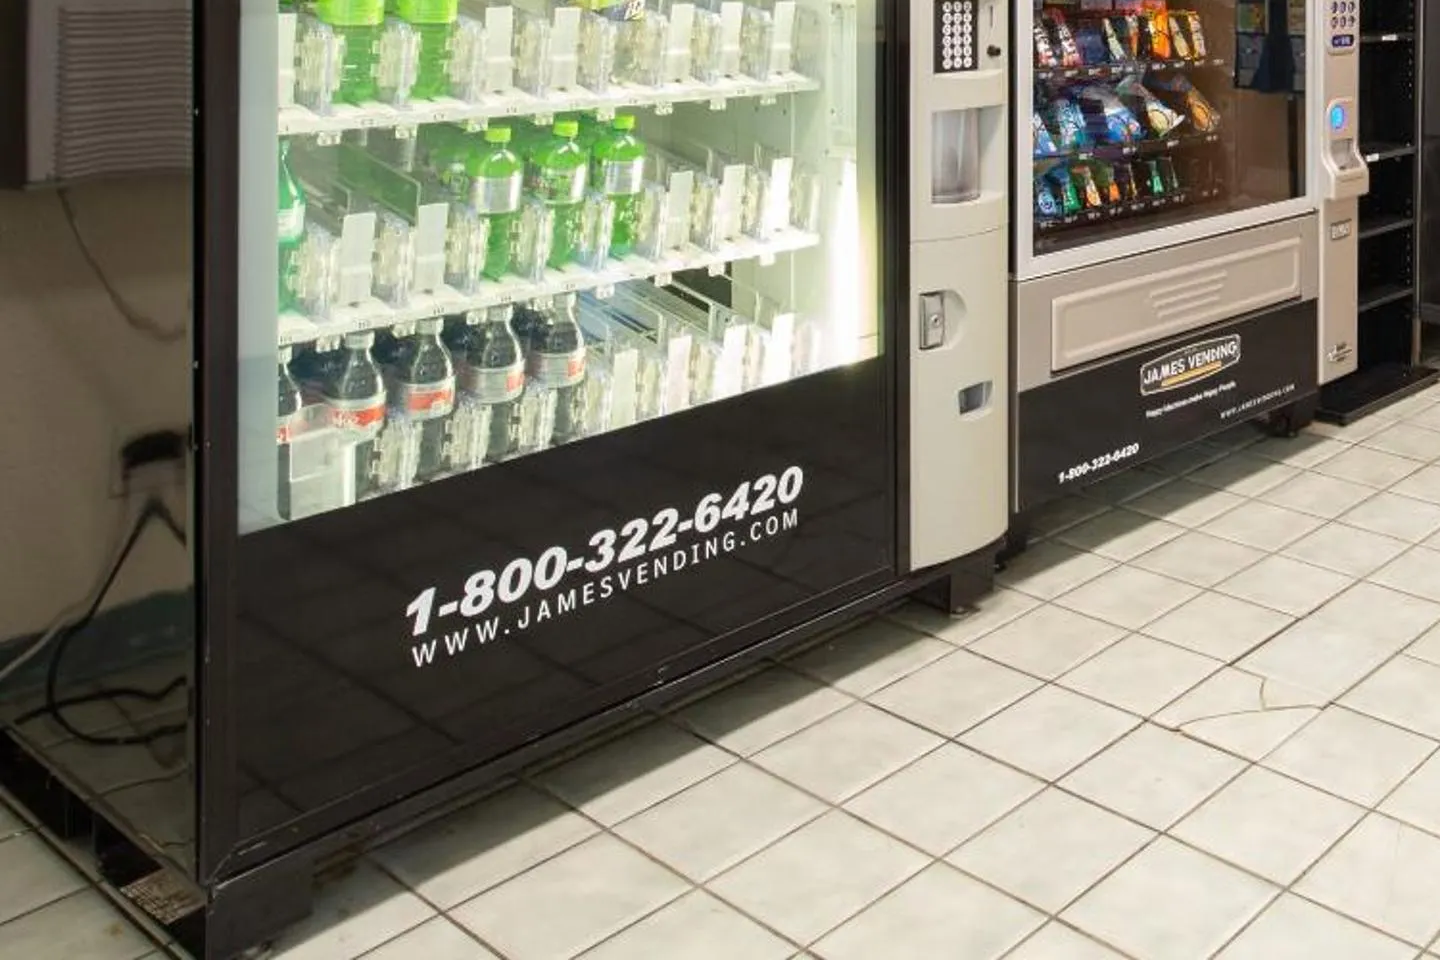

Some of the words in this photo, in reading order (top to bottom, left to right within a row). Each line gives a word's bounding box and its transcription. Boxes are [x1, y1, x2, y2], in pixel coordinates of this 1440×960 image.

[1143, 357, 1186, 385] JAMES
[1187, 340, 1238, 370] VENDING
[1058, 442, 1140, 484] 1-800-322-6420
[405, 465, 804, 638] 1-800-322-6420
[411, 507, 800, 668] WWW.JAMESVENDING.COM
